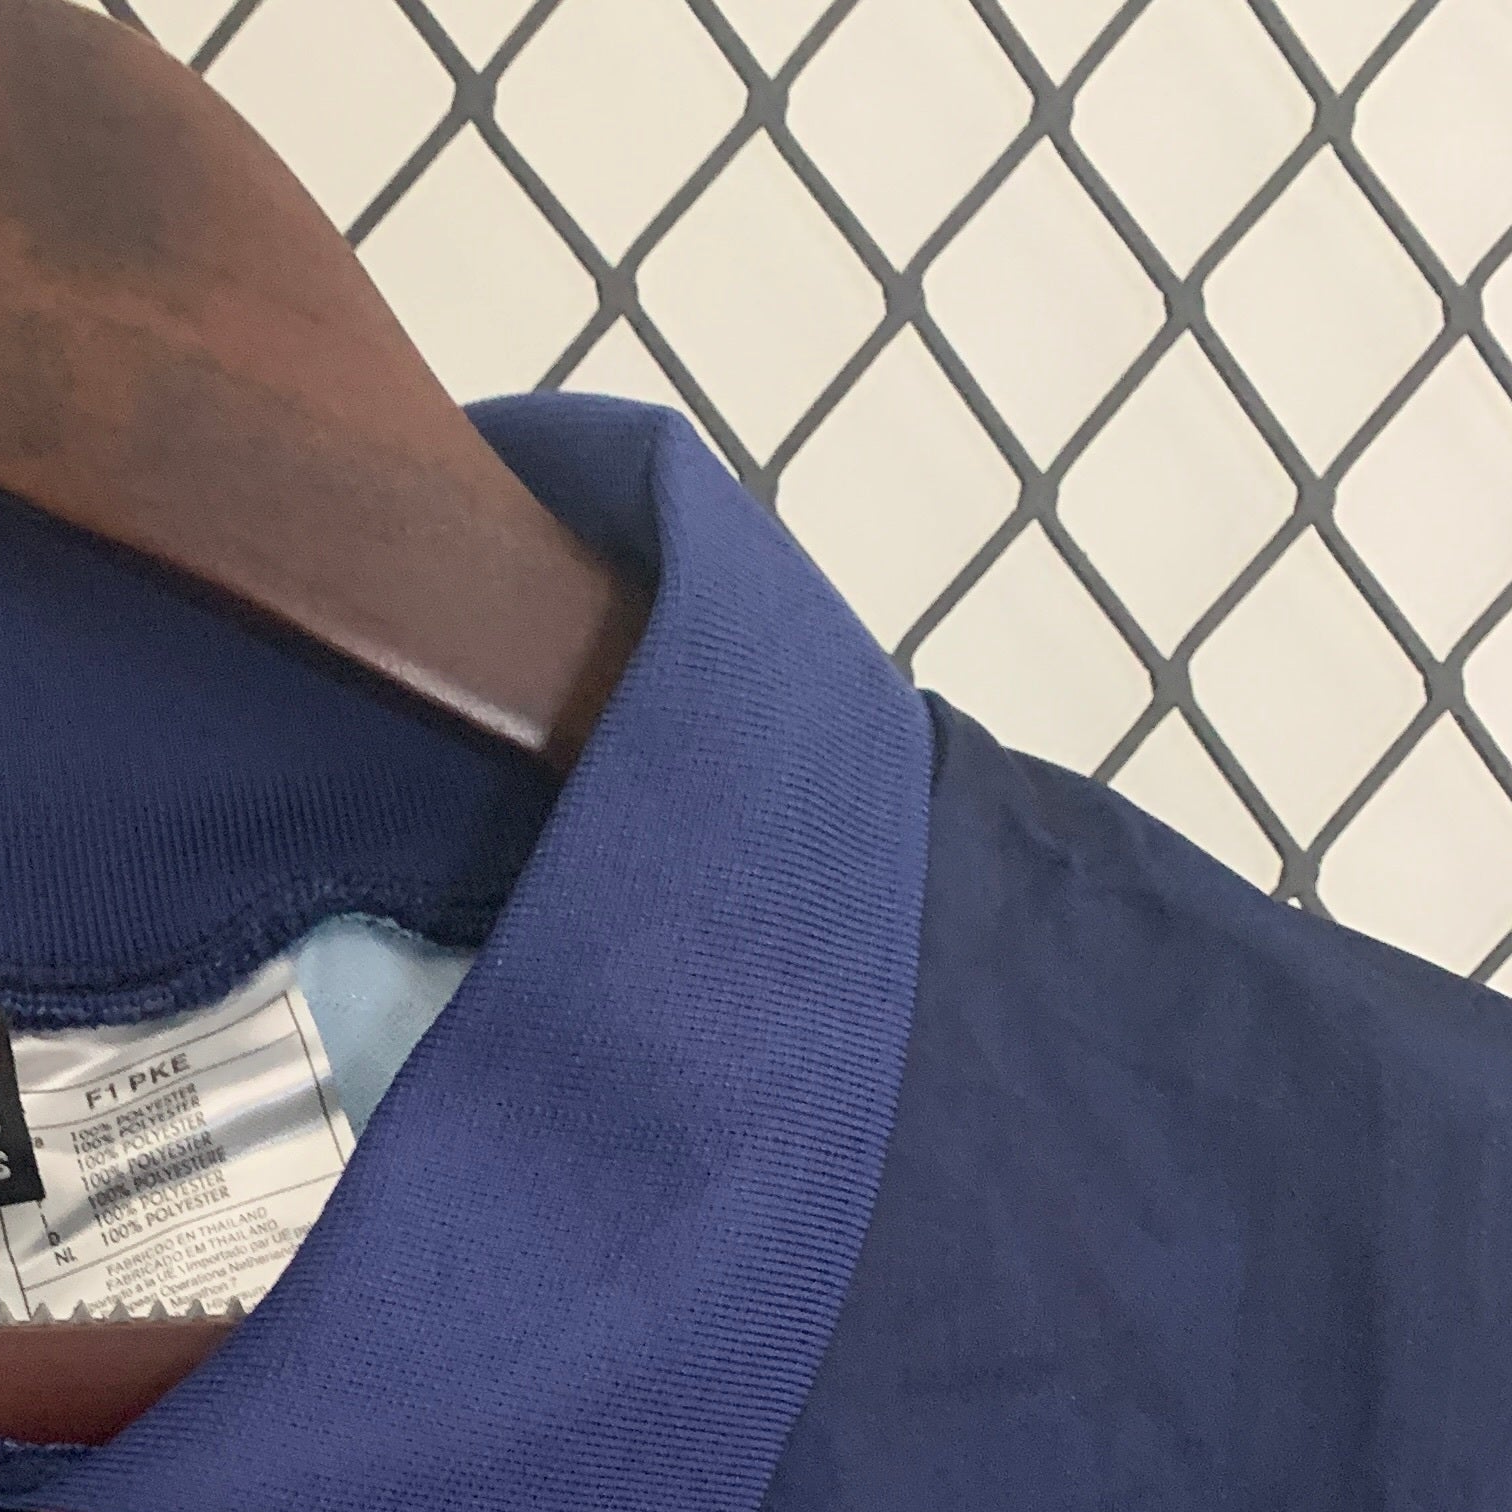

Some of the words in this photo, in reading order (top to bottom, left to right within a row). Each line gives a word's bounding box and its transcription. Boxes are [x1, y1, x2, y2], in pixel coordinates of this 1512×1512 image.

[128, 1052, 190, 1092] PKE
[116, 1083, 197, 1125] POLYESTER
[119, 1095, 200, 1137] POLYESTER
[77, 1149, 119, 1172] 100%
[122, 1111, 207, 1153] POLYESTER
[127, 1131, 213, 1174] POLYESTER
[94, 1202, 137, 1228] 100%
[139, 1169, 225, 1209] POLYESTER
[101, 1220, 143, 1246] 100%
[145, 1185, 231, 1226] POLYESTER
[198, 1206, 268, 1238] THAILAND
[208, 1219, 279, 1248] THAILAND
